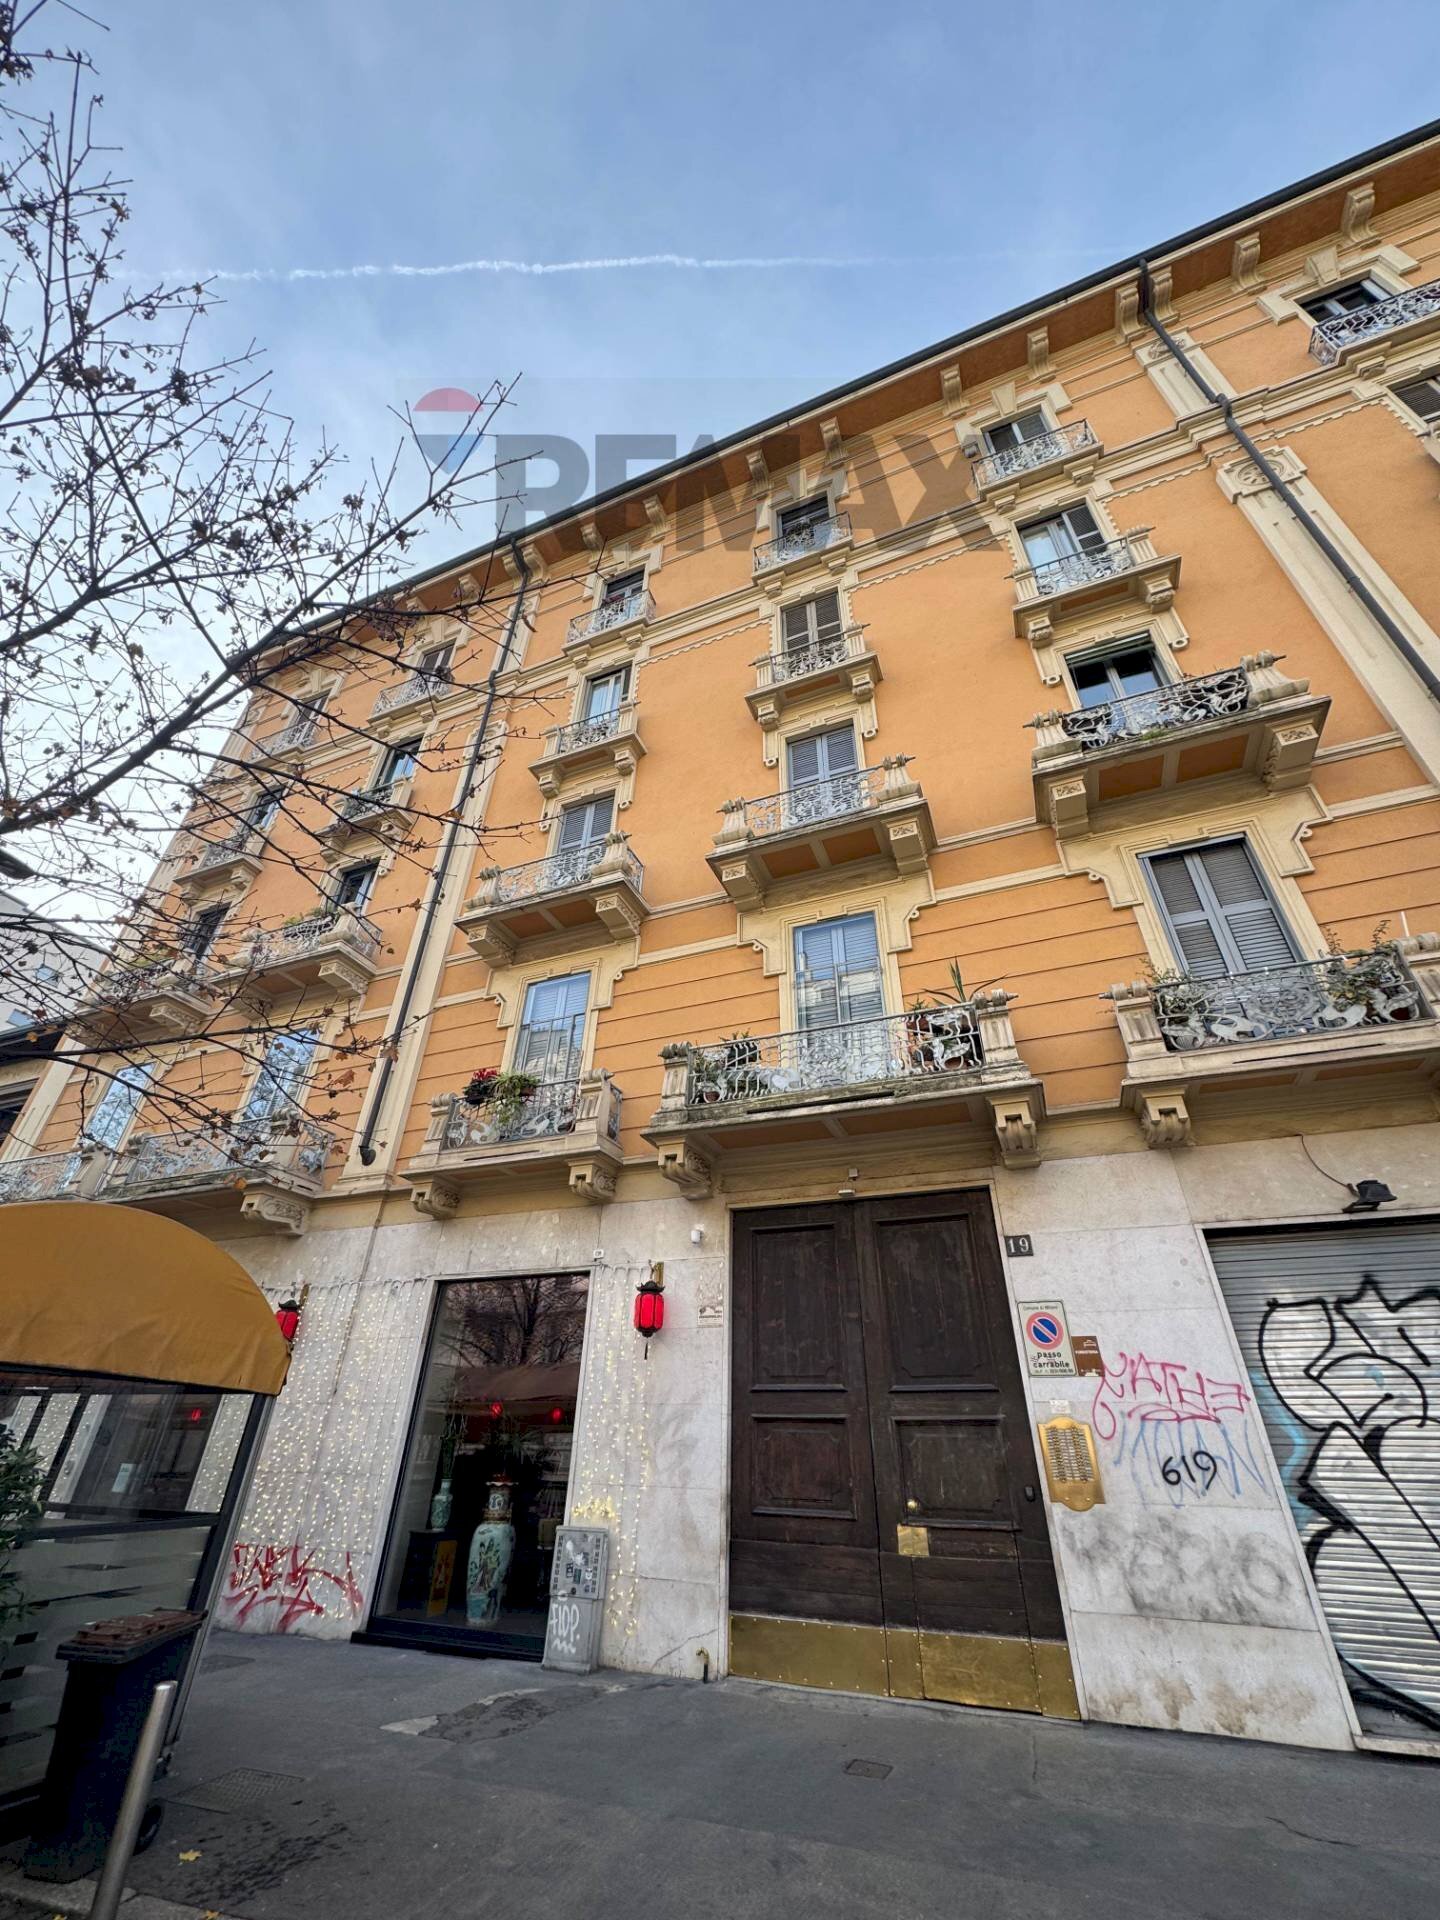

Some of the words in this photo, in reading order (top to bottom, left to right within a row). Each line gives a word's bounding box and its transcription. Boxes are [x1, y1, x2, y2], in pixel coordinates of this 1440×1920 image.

[1009, 1238, 1029, 1253] 19
[1036, 1351, 1062, 1359] passo
[1033, 1360, 1070, 1368] carrabile
[1162, 1450, 1218, 1490] 619
